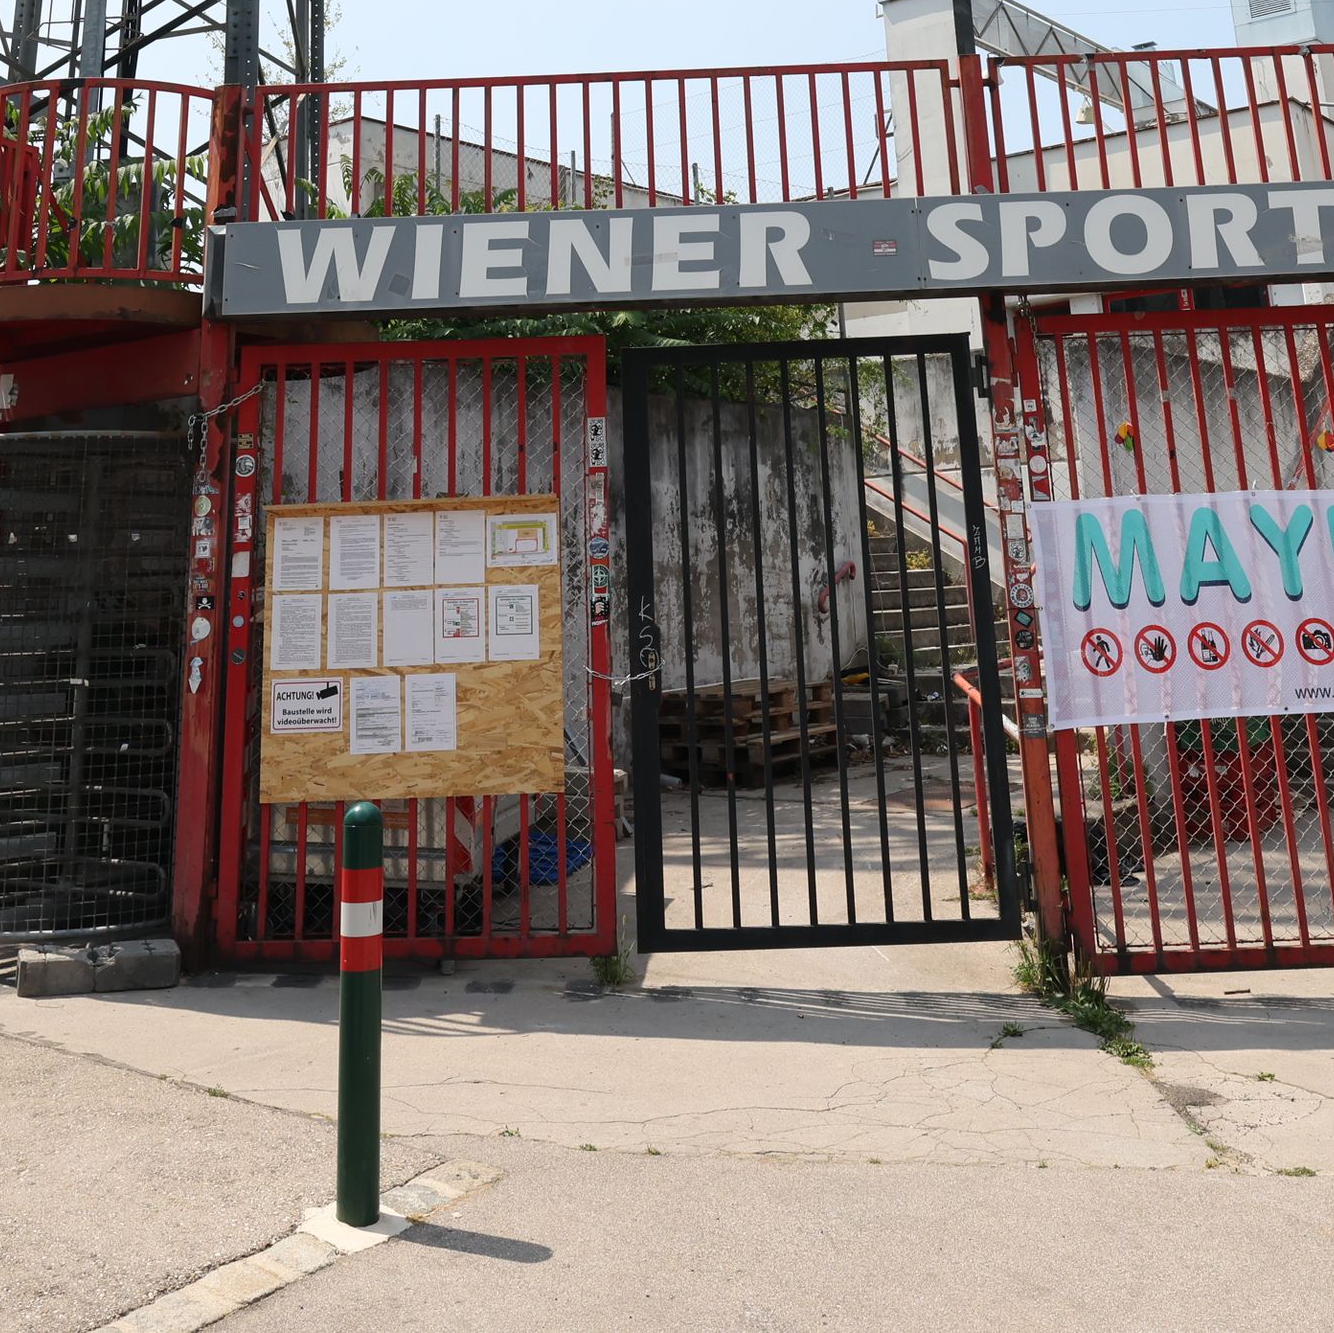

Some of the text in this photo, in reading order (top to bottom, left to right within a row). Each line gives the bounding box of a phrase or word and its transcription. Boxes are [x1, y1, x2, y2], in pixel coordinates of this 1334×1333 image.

[276, 210, 813, 304] WIENER
[276, 690, 315, 701] ACHTUNG!
[282, 707, 333, 716] Baustelle wird
[277, 716, 337, 726] videoüberwacht!
